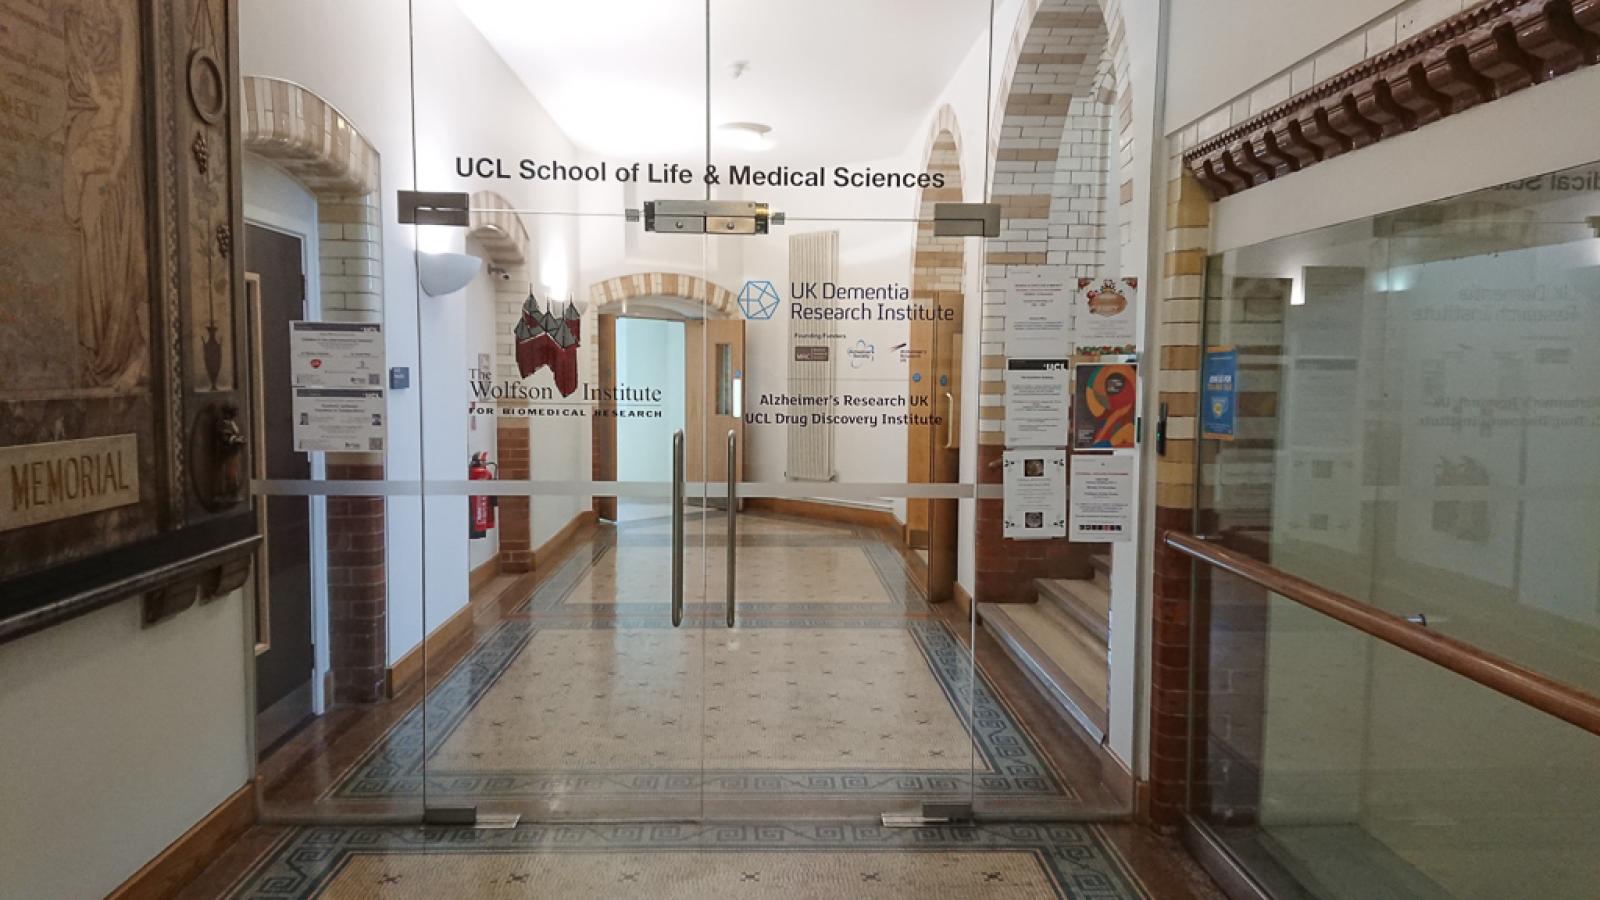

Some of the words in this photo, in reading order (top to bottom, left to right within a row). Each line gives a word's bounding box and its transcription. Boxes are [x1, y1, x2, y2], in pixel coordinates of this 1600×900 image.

[455, 157, 512, 179] UCL
[519, 158, 607, 181] School
[615, 162, 640, 182] of
[648, 162, 693, 184] Life
[703, 164, 721, 185] &
[729, 165, 826, 187] Medical
[833, 166, 946, 188] Sciences
[791, 282, 818, 300] UK
[822, 282, 910, 300] Dementia
[791, 302, 872, 320] Research
[877, 303, 954, 321] Institute
[468, 368, 492, 381] The
[469, 380, 553, 400] Wolfson
[583, 383, 663, 402] Institute
[759, 393, 840, 407] Alzheimer's
[843, 394, 906, 407] Research
[909, 394, 929, 407] UK
[468, 407, 495, 415] FOR
[502, 407, 588, 417] BIOMEDICAL
[594, 409, 663, 418] RESEARCH
[745, 412, 772, 425] UCL
[775, 413, 808, 427] Drug
[812, 412, 878, 428] Discovery
[881, 412, 943, 426] Institute
[10, 449, 130, 511] MEMORIAL
